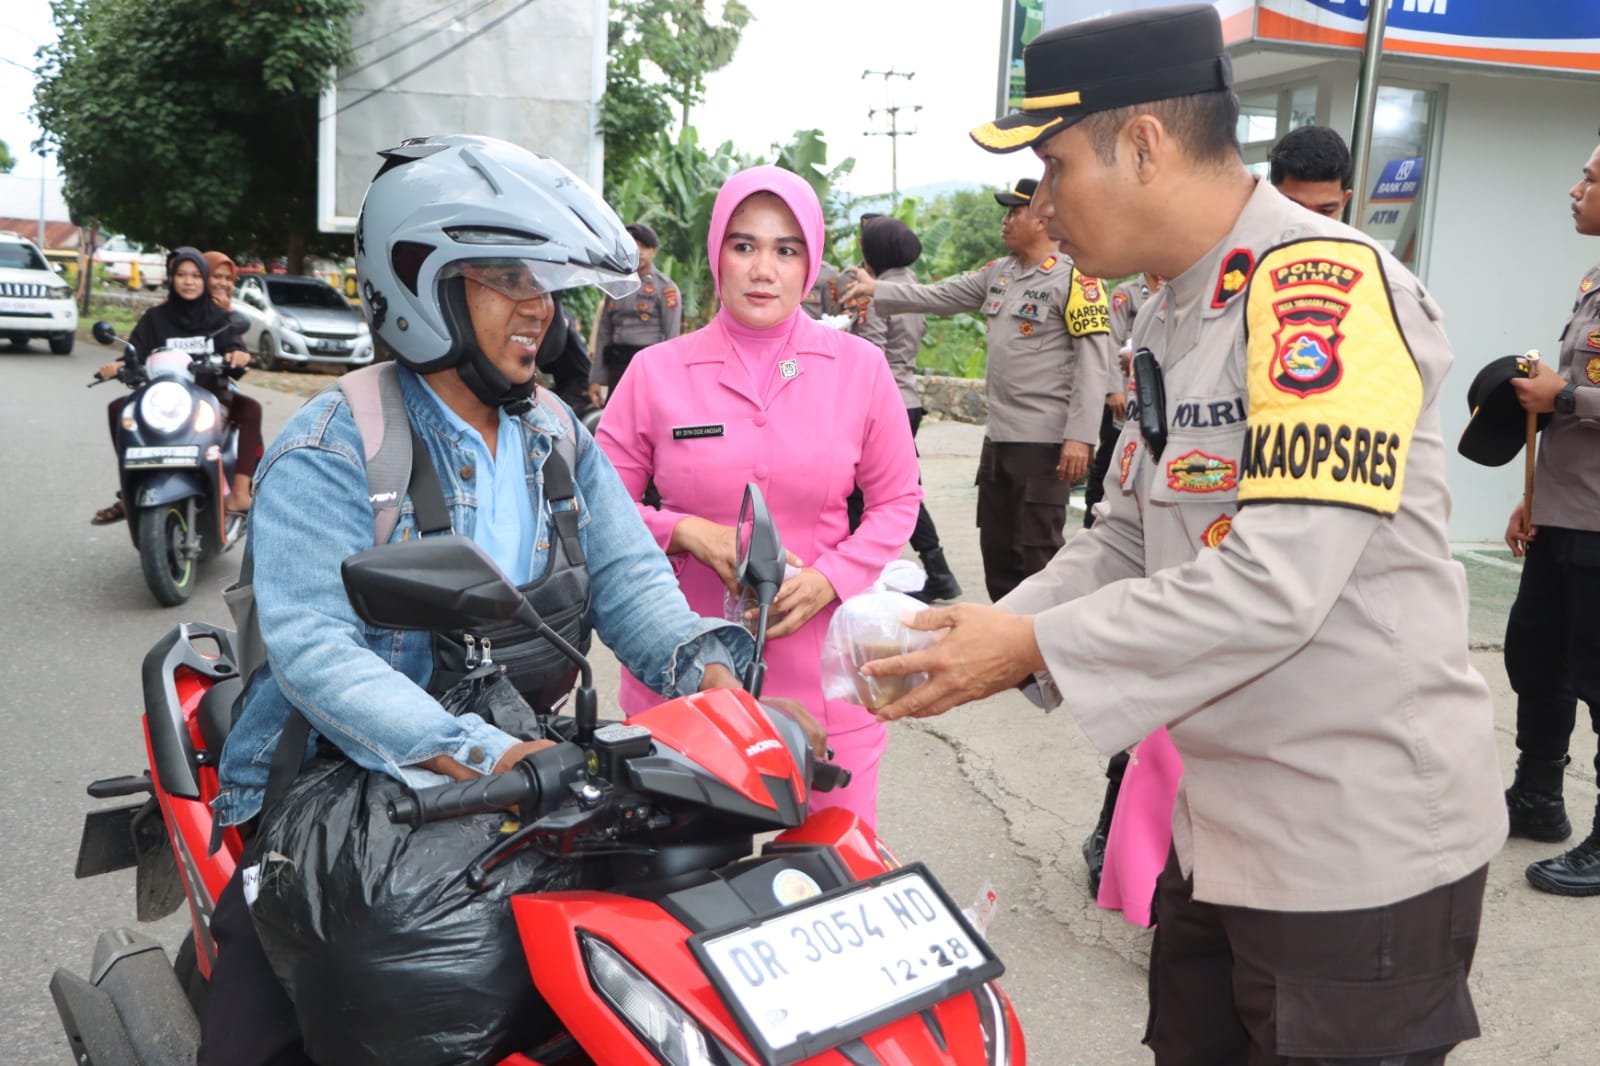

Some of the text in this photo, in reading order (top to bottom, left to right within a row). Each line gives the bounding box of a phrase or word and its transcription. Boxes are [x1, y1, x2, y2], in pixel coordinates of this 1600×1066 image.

[1377, 182, 1416, 193] BANK BRI
[1368, 209, 1399, 225] ATM
[1277, 262, 1355, 281] POLRES
[1287, 273, 1339, 284] BIMA
[1023, 289, 1050, 301] POLRI
[1073, 317, 1099, 332] OPS
[746, 739, 783, 756] HONDA
[728, 940, 790, 987] DR
[790, 904, 885, 962] 3054
